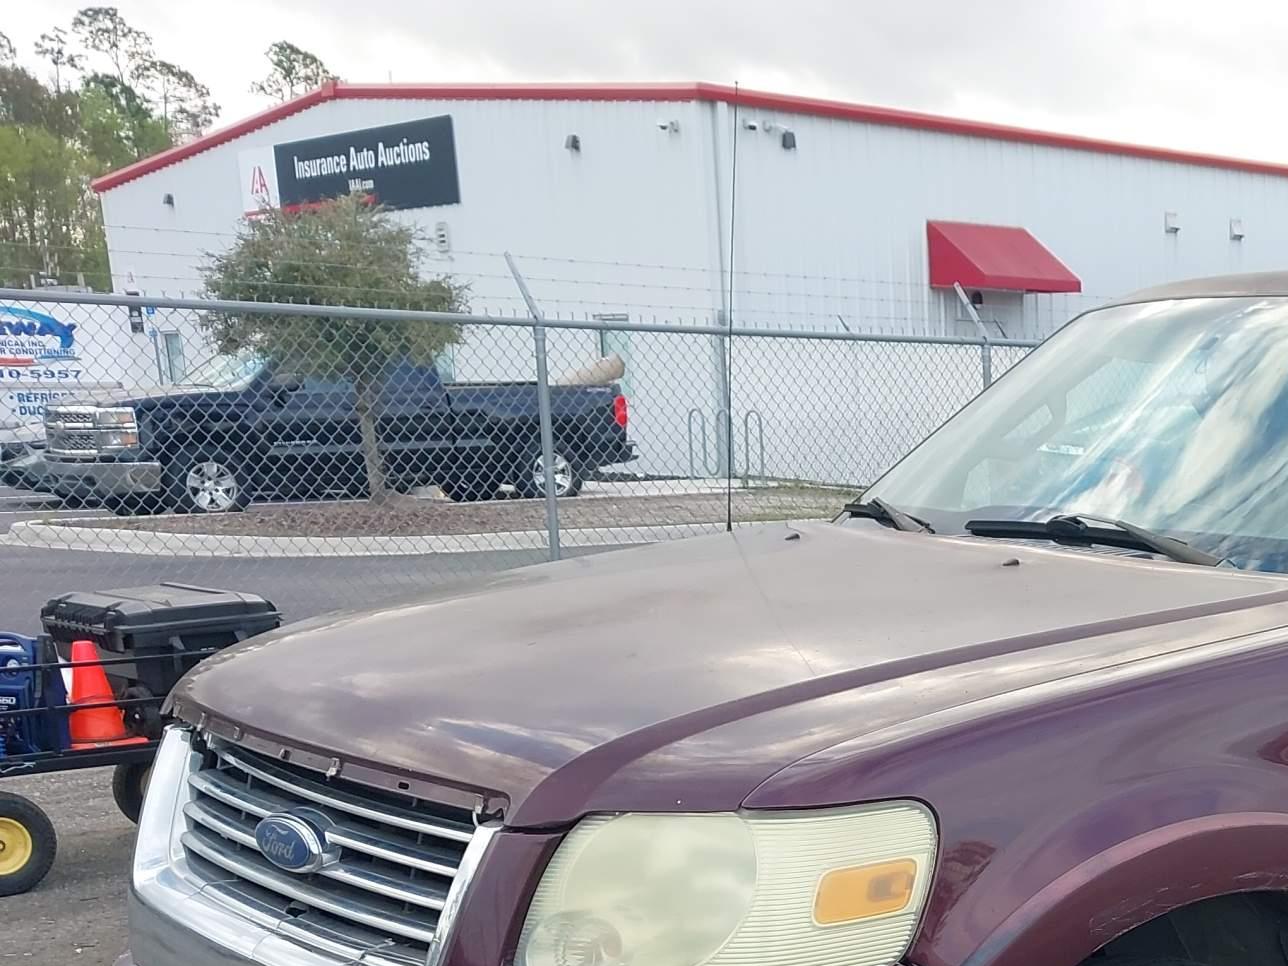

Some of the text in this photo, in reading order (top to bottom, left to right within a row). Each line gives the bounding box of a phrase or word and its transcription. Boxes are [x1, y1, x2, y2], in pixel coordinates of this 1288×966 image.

[294, 138, 430, 179] Insurance Auto Auctions
[261, 823, 296, 861] Ford
